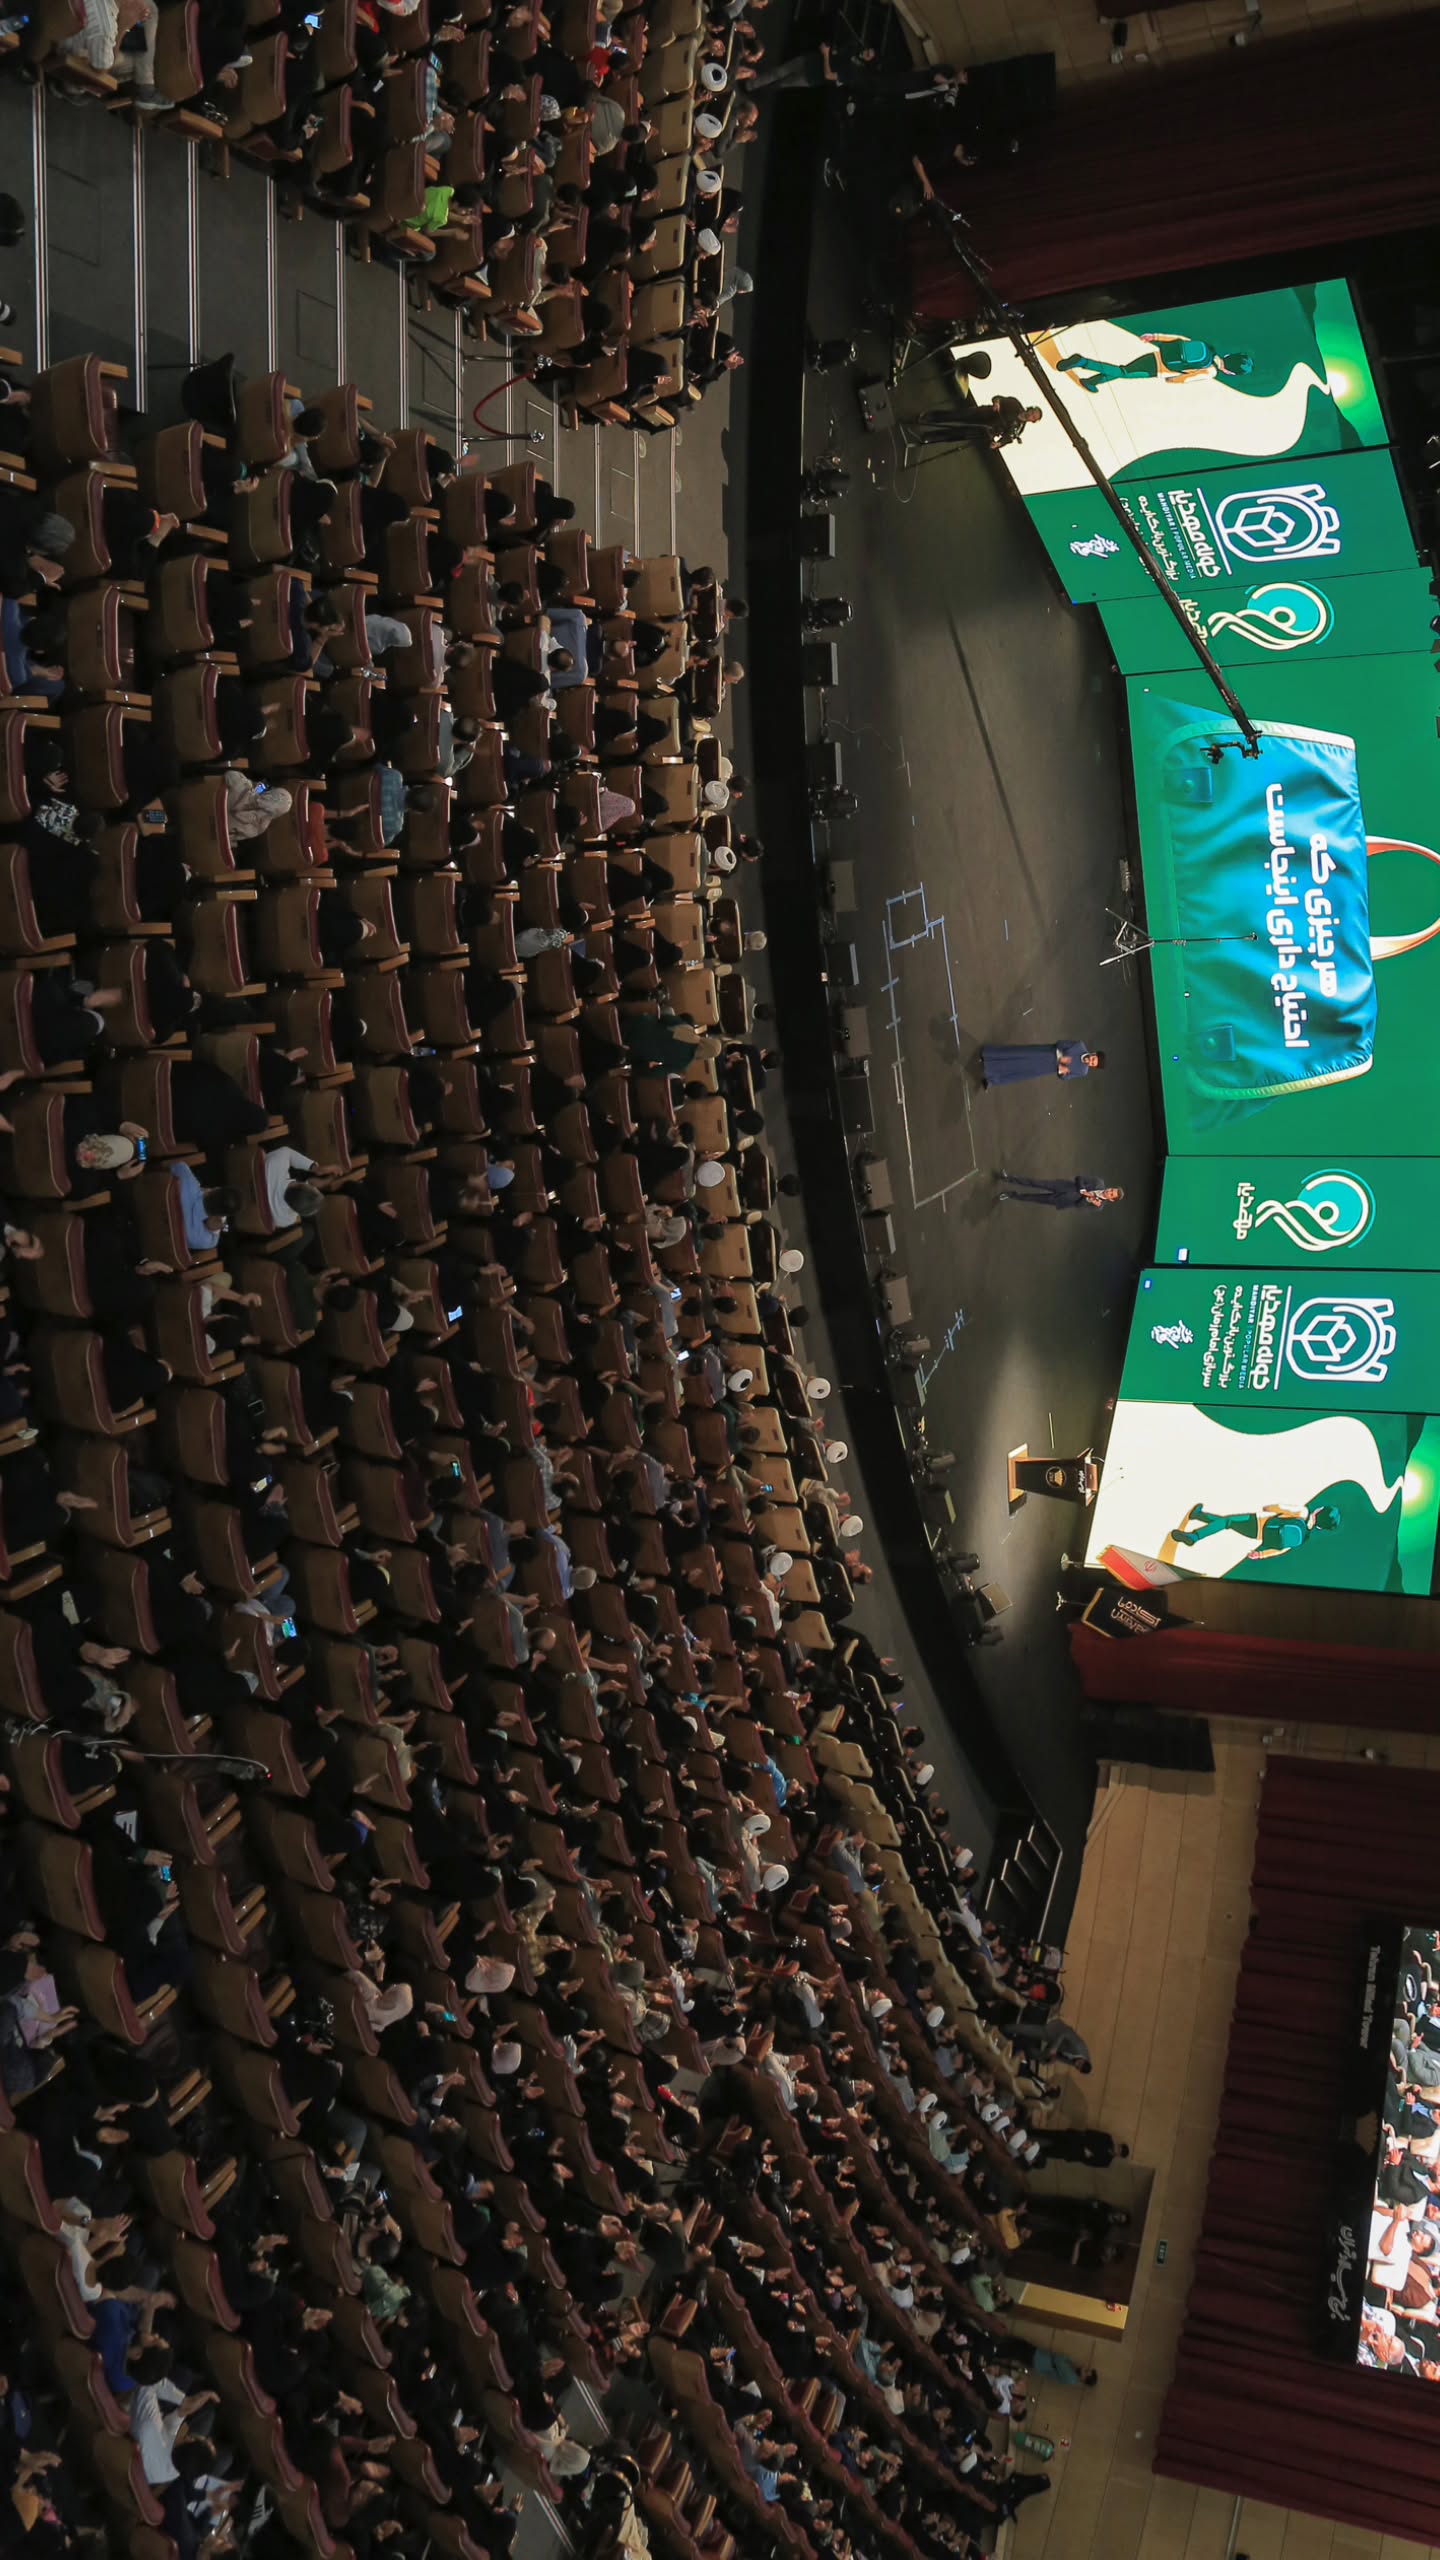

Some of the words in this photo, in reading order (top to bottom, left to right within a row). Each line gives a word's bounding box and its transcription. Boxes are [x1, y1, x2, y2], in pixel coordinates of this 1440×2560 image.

[1157, 492, 1176, 526] MAHDIYAR
[1172, 531, 1189, 560] POPULAR
[1183, 560, 1196, 579] MEDIA
[1168, 490, 1206, 542] مهدیار
[1264, 783, 1299, 906] اینجاست
[1309, 833, 1337, 885] که
[1266, 908, 1303, 971] داری
[1305, 888, 1340, 958] چیزی
[1311, 960, 1338, 998] هر
[1270, 972, 1310, 1049] احتیاج
[1232, 1182, 1256, 1241] مهدیار
[1248, 1284, 1259, 1324] MAHDIYAR
[1258, 1285, 1283, 1345] مهدیار
[1208, 1328, 1220, 1352] امام
[1241, 1330, 1253, 1363] POPULAR
[1201, 1352, 1216, 1388] سربازی
[1238, 1365, 1247, 1389] MEDIA
[1367, 1945, 1381, 1981] Tehran
[1360, 2014, 1373, 2049] Tower
